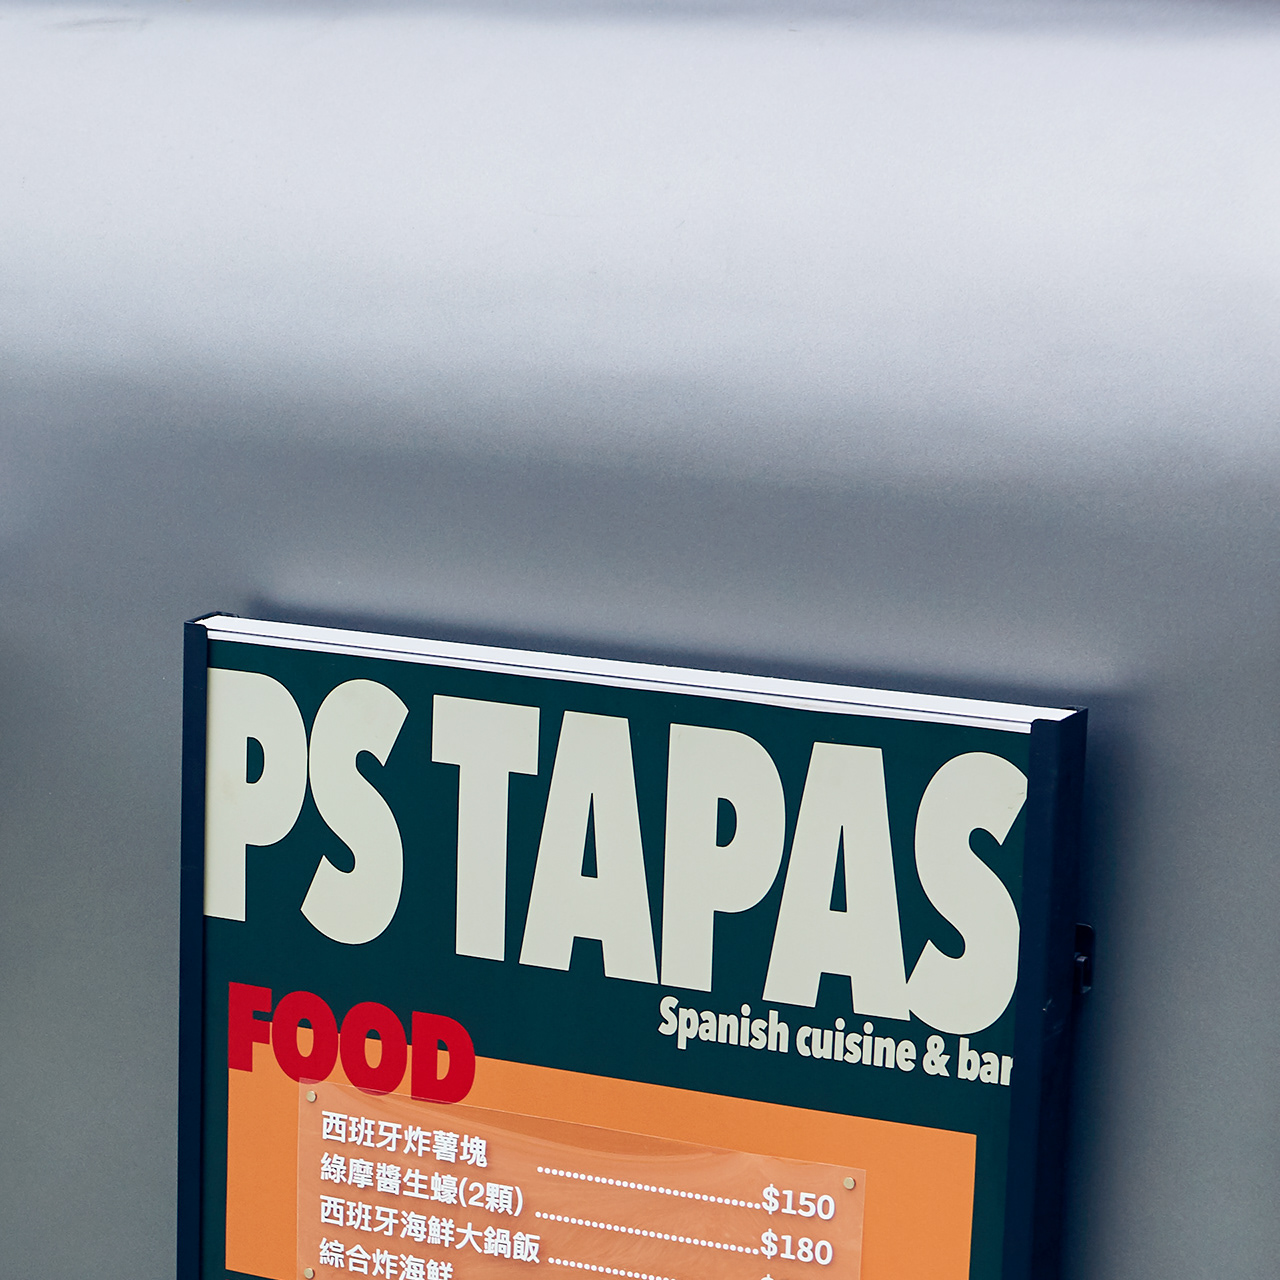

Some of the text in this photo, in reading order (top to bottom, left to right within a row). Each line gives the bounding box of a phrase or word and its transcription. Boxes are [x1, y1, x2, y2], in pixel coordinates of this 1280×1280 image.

[204, 668, 1028, 1035] PS TAPAS
[228, 981, 476, 1105] FOOD
[657, 996, 1014, 1086] Spanish cuisine & bar
[321, 1110, 835, 1221] 西班牙炸薯塊 $150
[319, 1194, 541, 1264] 西班牙海鮮大鍋飯
[760, 1228, 833, 1266] $180
